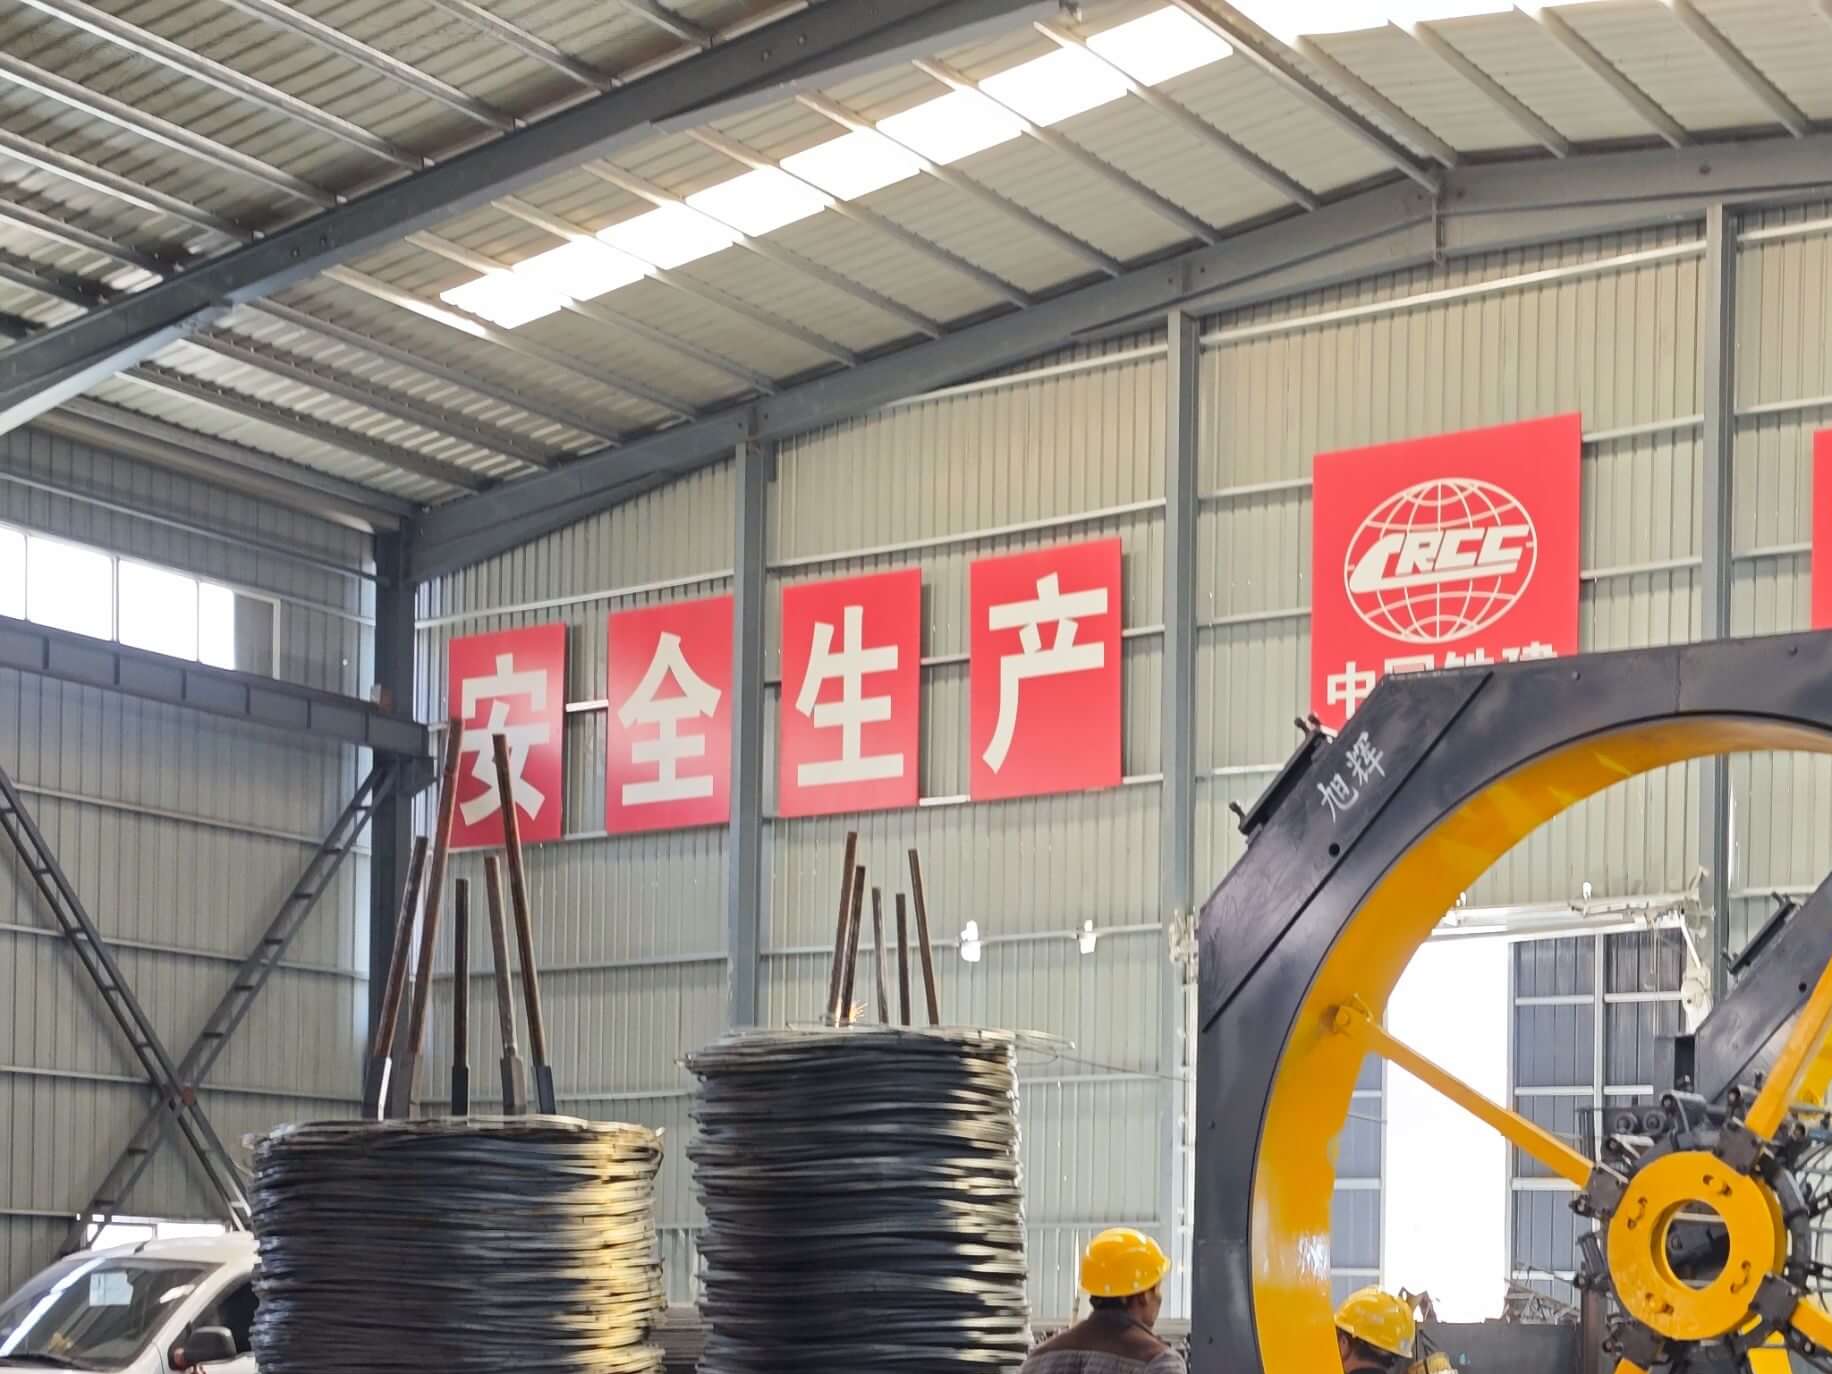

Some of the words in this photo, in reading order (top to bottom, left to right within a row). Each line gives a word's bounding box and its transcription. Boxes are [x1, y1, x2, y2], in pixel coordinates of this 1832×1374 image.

[1350, 524, 1531, 594] CRCC
[459, 573, 1108, 825] 安全生产
[1316, 731, 1386, 824] 旭辉
